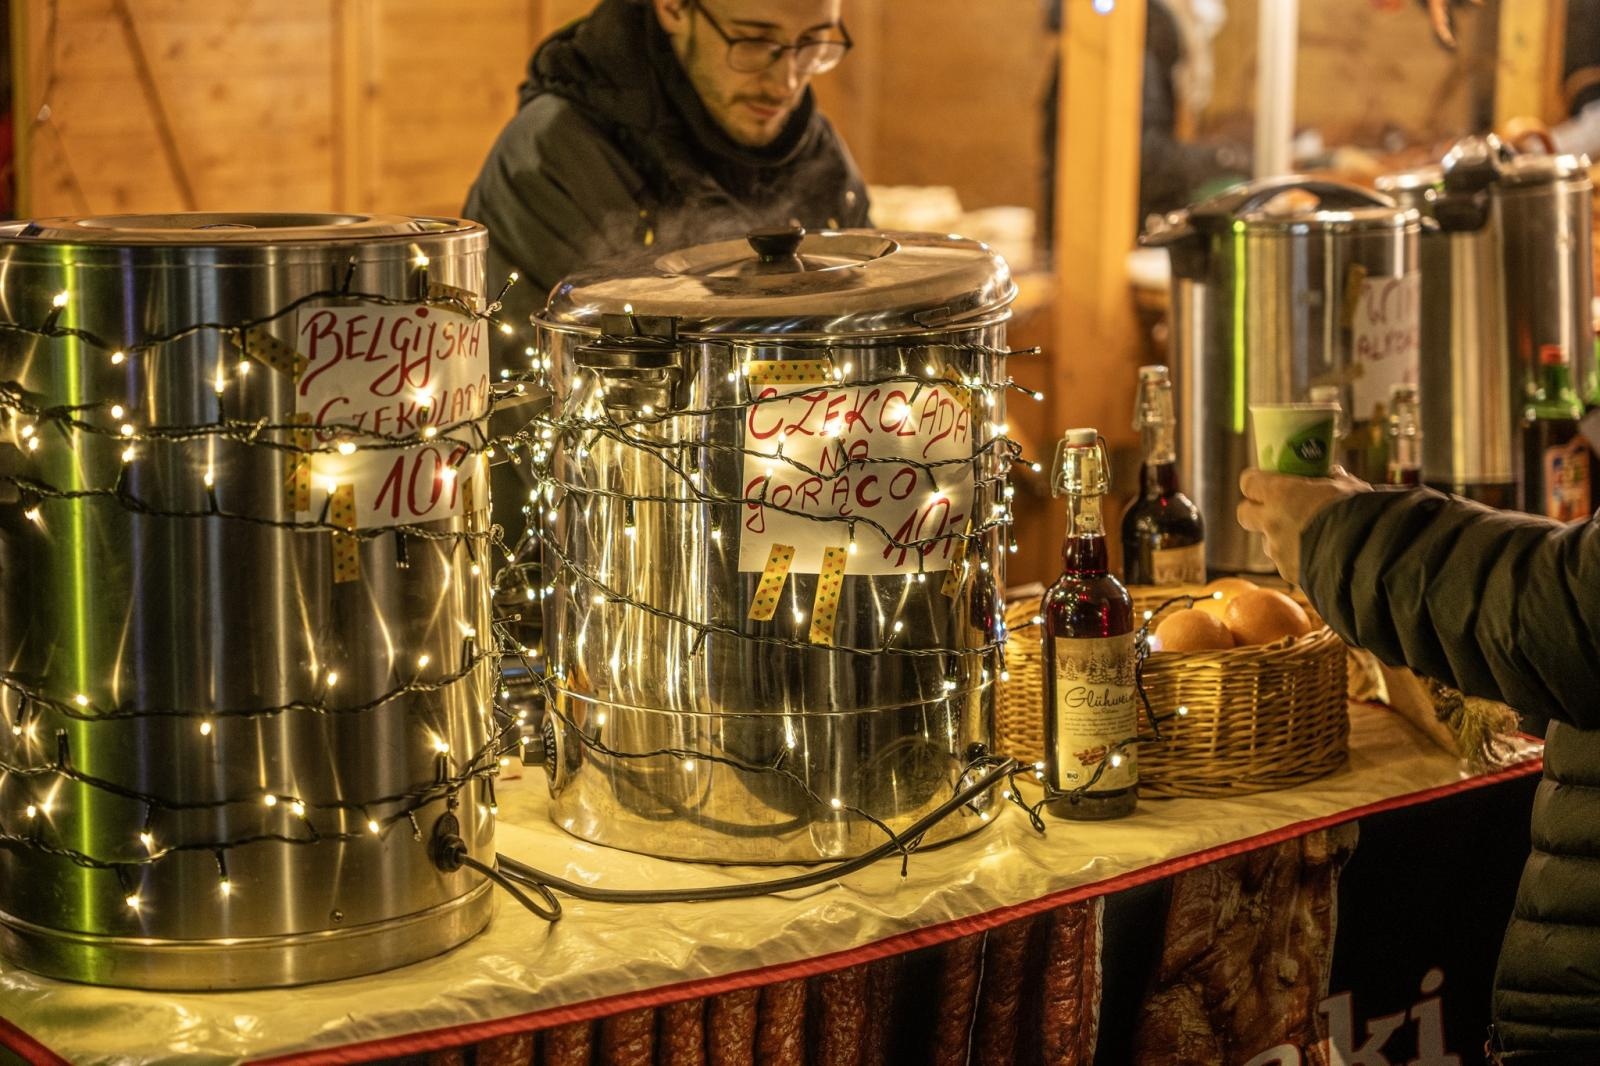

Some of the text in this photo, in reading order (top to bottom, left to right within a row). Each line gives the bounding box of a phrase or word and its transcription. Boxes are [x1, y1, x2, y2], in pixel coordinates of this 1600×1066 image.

[749, 387, 968, 458] CZEKOLADA
[819, 439, 869, 472] NA
[1065, 686, 1136, 708] Glühwei
